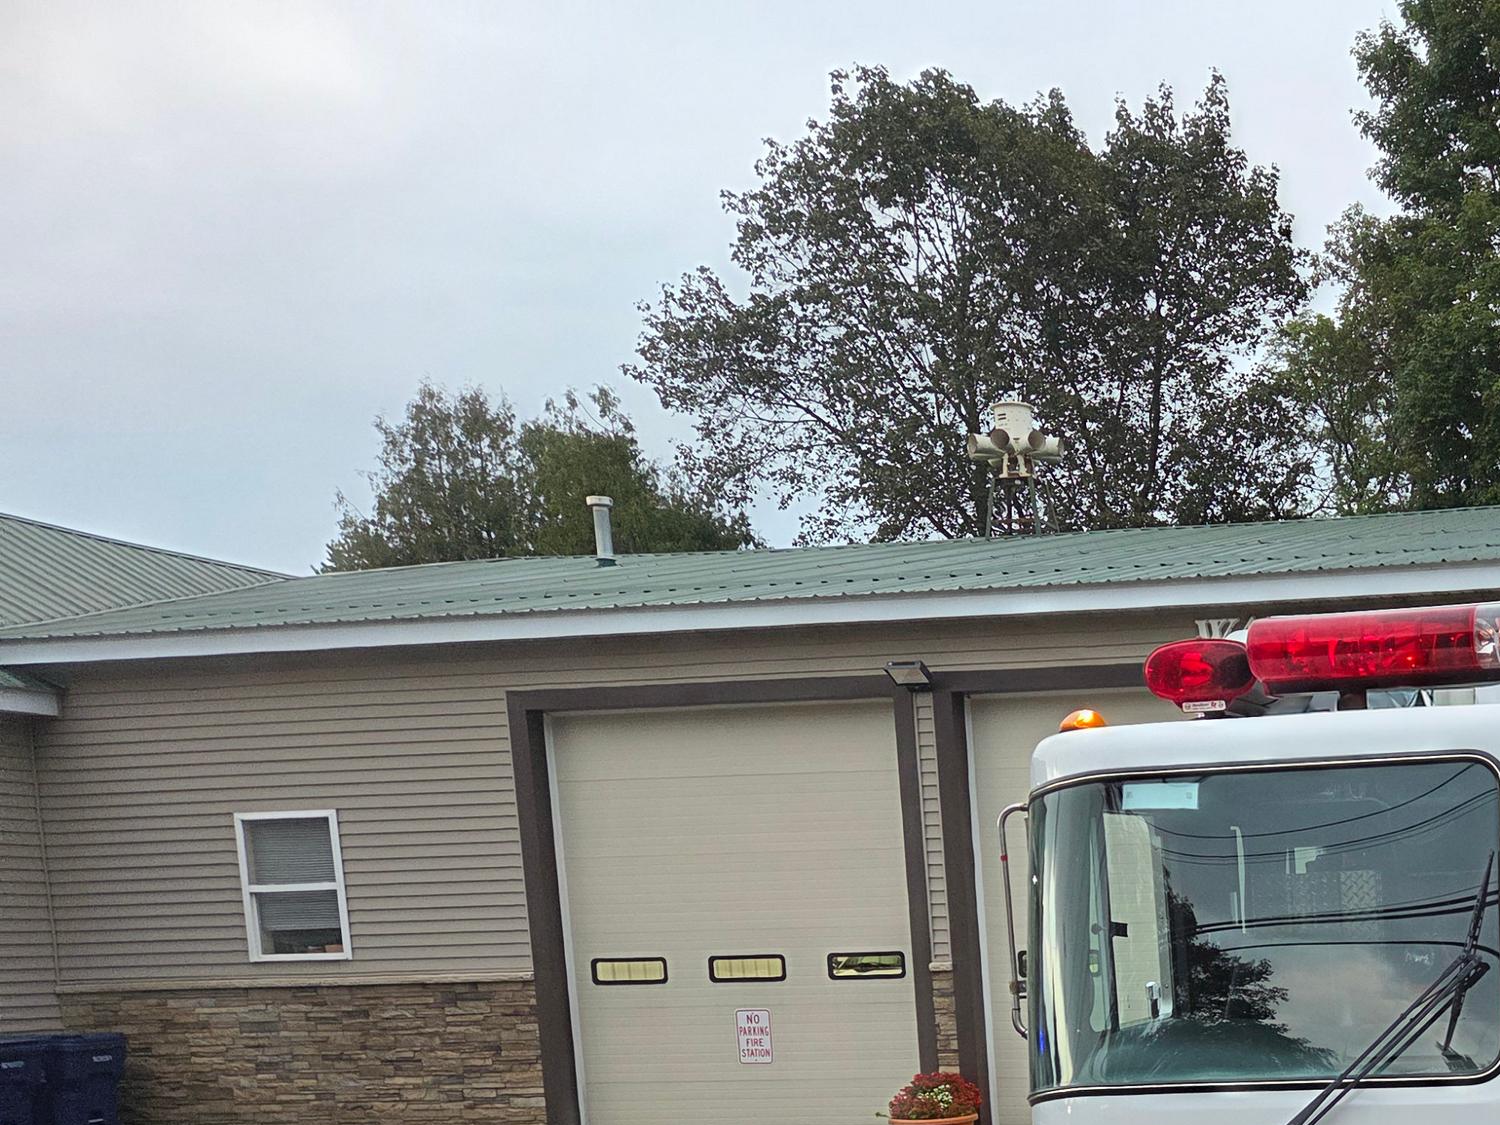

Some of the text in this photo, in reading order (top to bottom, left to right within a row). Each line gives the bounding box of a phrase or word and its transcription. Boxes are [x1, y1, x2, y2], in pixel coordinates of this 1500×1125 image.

[746, 1014, 760, 1024] NO
[739, 1026, 770, 1036] PARKING
[746, 1038, 764, 1047] FIRE
[741, 1048, 771, 1058] STATION
